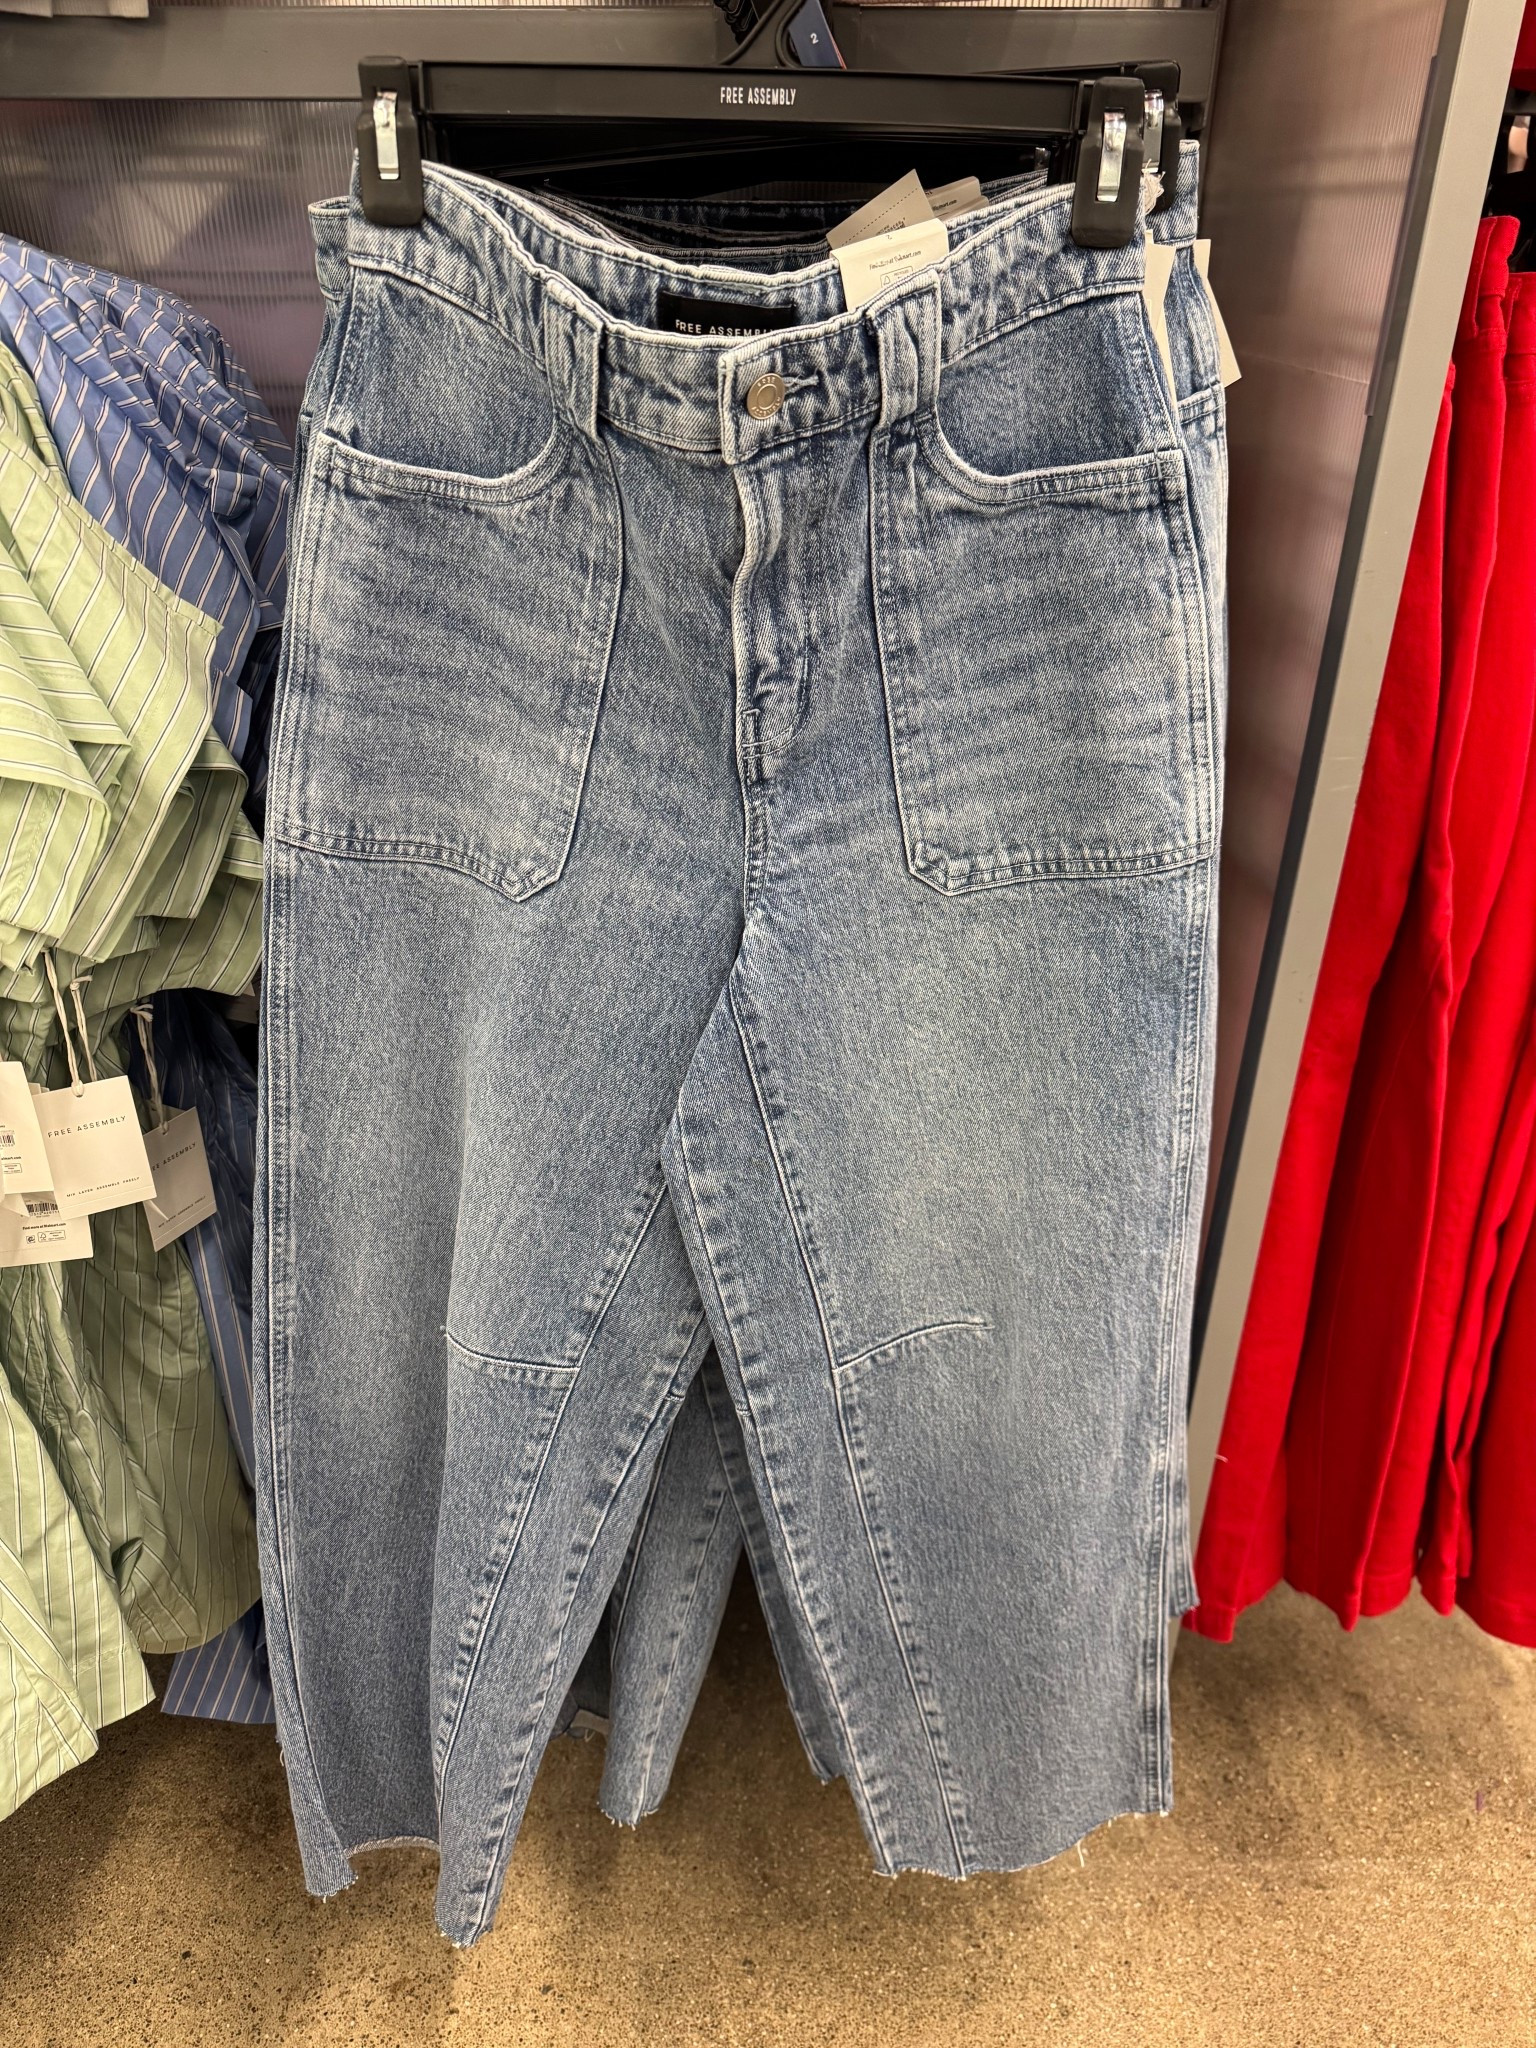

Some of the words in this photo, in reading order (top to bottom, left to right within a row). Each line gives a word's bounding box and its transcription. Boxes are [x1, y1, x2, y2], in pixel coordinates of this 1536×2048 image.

[810, 32, 819, 45] 2
[720, 86, 744, 104] FREE
[747, 87, 797, 105] ASSEMBLY
[675, 318, 703, 334] FREE
[47, 1127, 73, 1139] FREE
[77, 1115, 127, 1132] ASSEMBLY
[163, 1143, 197, 1165] ASSEMBLY
